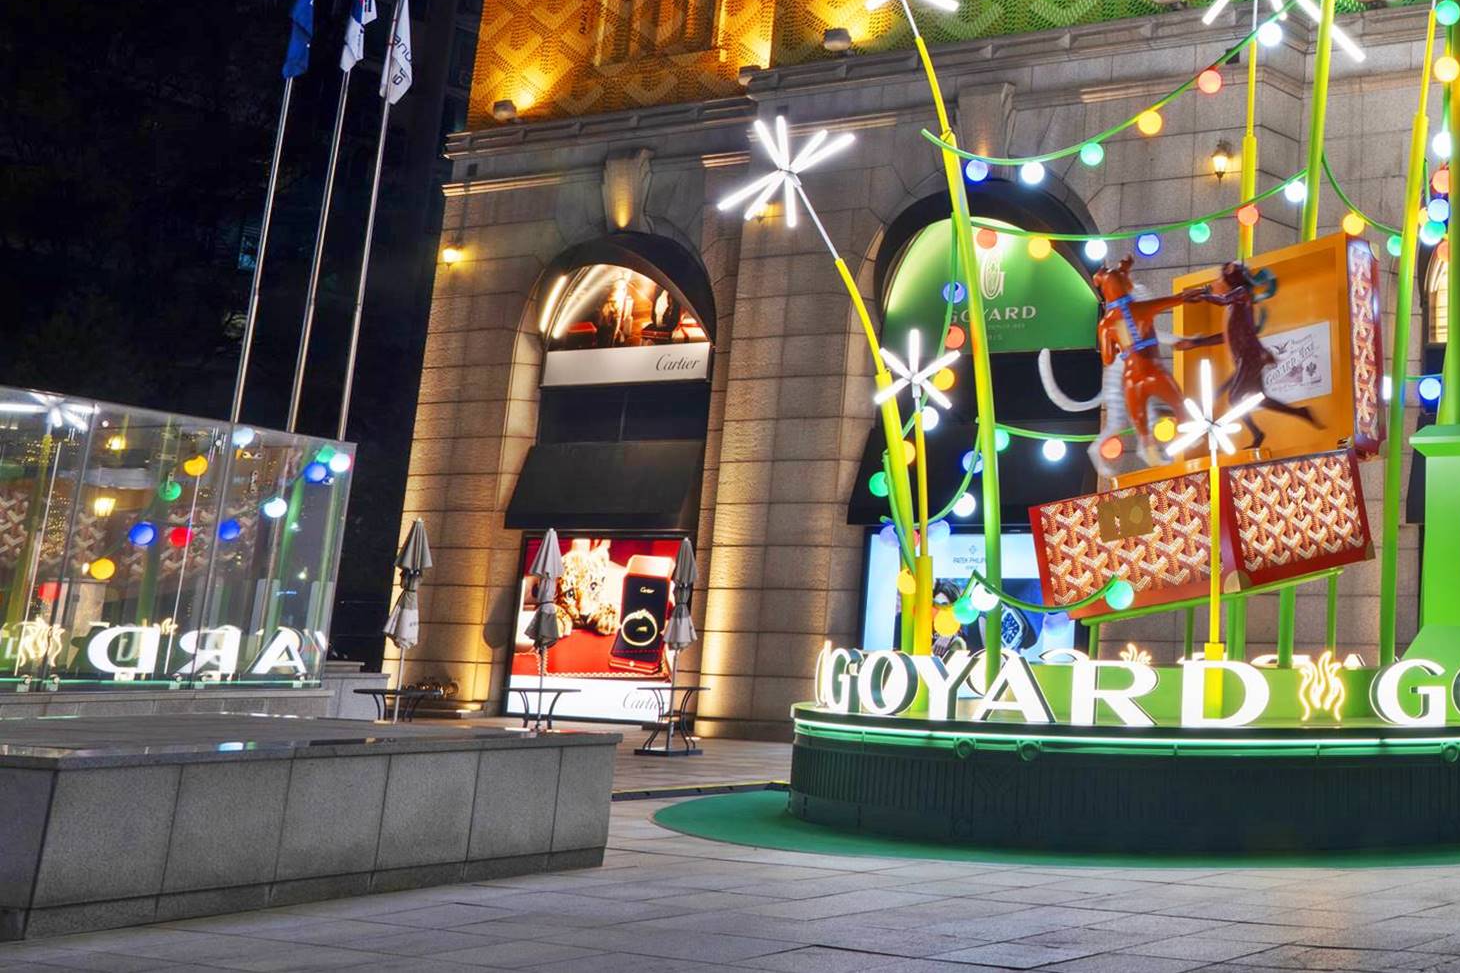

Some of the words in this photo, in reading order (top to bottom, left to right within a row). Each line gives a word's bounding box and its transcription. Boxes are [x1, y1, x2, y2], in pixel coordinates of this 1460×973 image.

[950, 306, 1037, 323] OARD
[656, 354, 701, 371] Cartier
[828, 648, 1270, 727] GOYARD
[623, 689, 669, 710] Cartie
